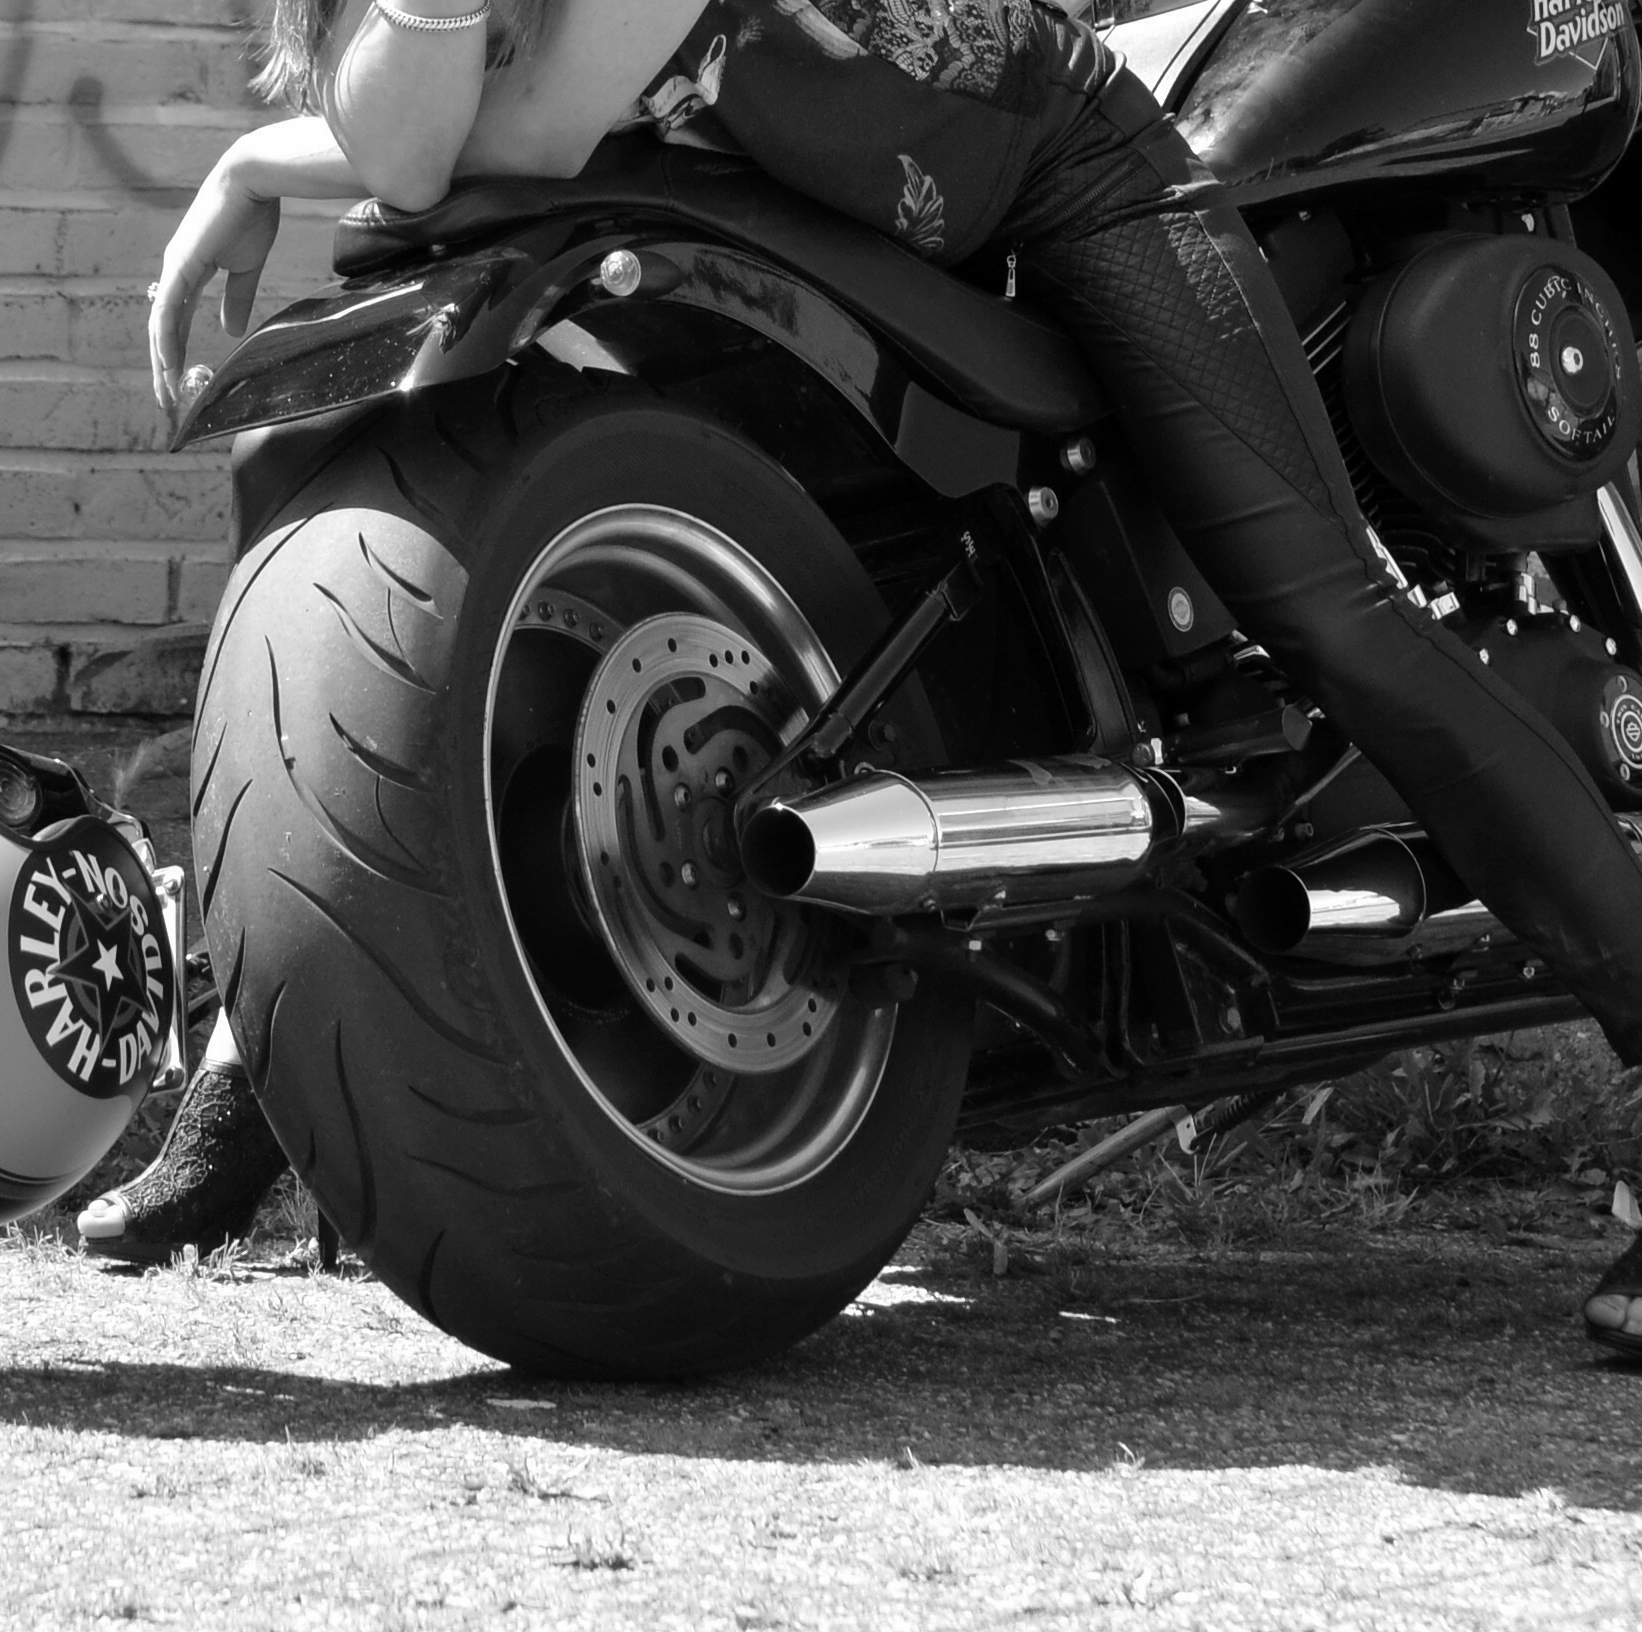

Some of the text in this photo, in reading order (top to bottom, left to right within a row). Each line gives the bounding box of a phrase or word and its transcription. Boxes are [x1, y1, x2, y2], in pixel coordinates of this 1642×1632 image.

[1539, 0, 1626, 58] Davidson
[1530, 276, 1573, 326] CUBIC
[1528, 332, 1541, 369] 88
[1547, 405, 1616, 445] SOFTAIL
